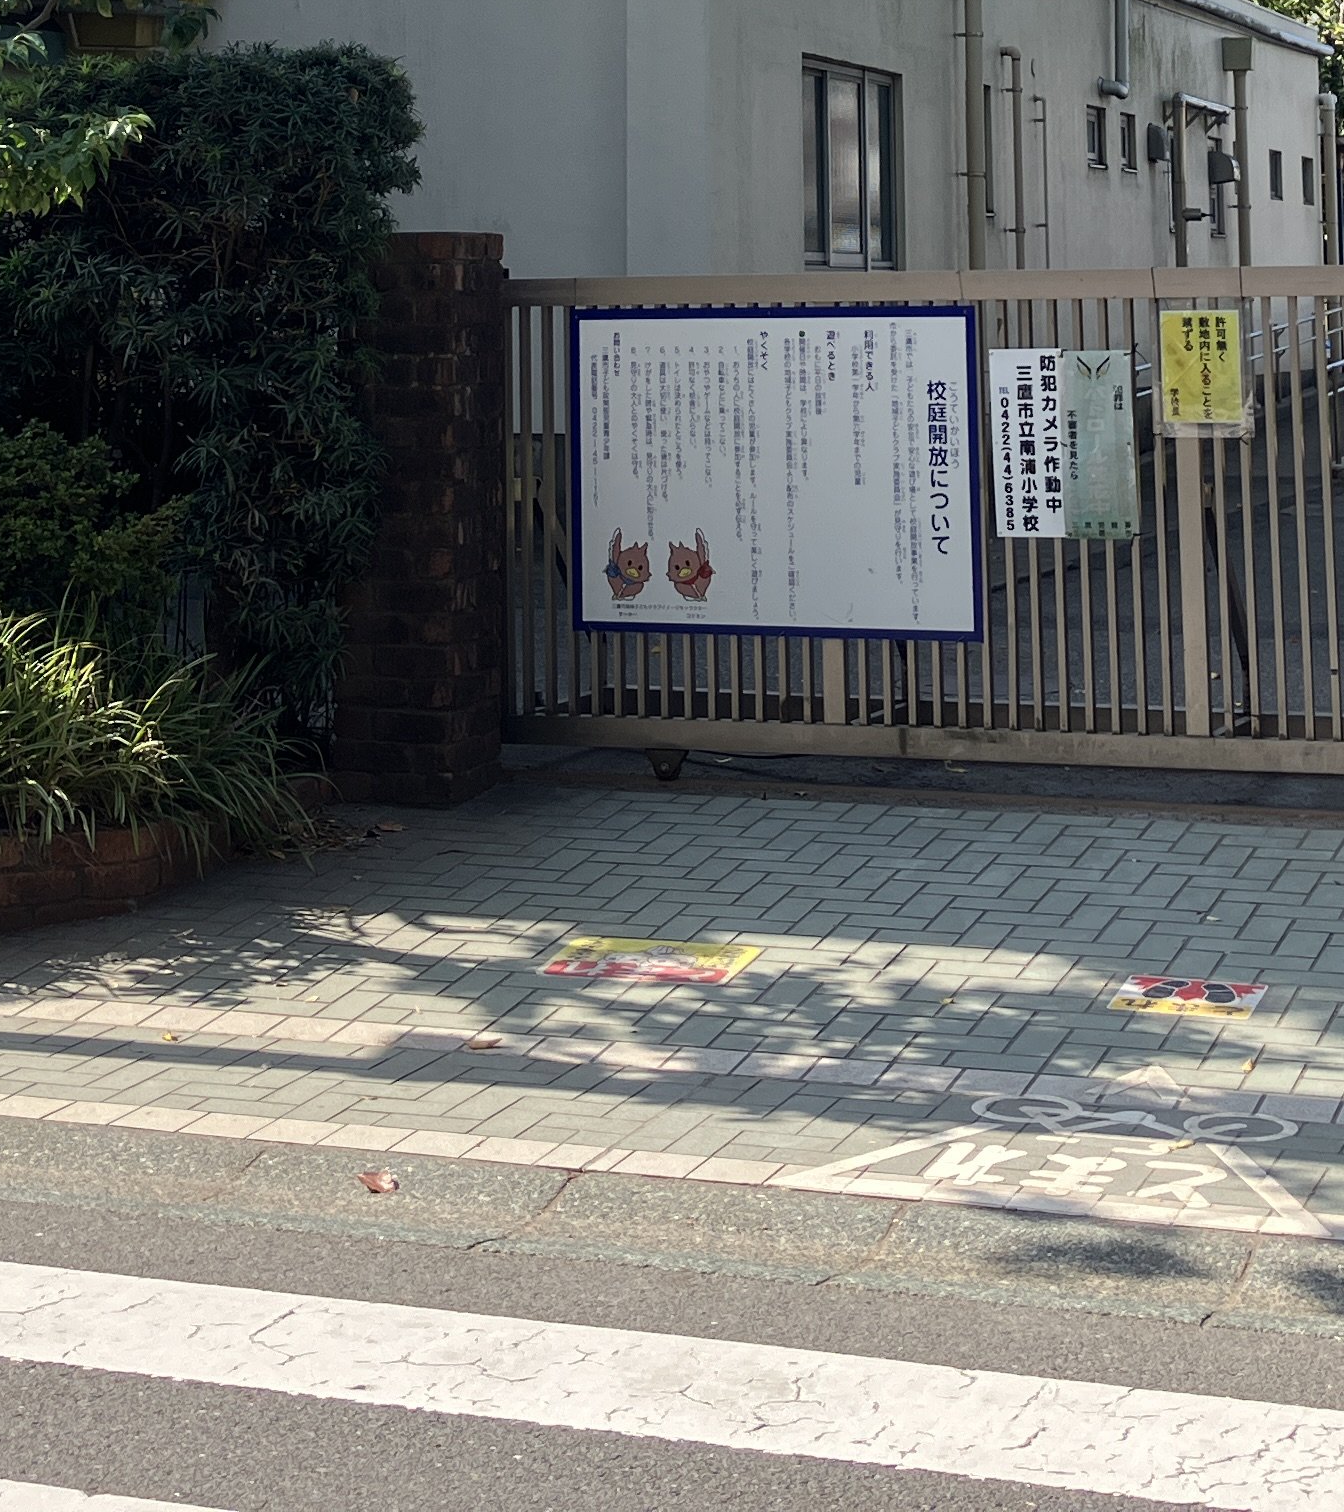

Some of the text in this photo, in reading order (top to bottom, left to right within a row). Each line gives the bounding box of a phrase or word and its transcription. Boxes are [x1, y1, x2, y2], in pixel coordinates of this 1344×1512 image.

[759, 330, 769, 371] やくそく
[825, 330, 836, 382] 遊べるとき
[863, 330, 874, 392] 利用できる人
[1198, 316, 1213, 420] 敷地内に入ることを
[1215, 316, 1227, 362] 許可無く
[948, 381, 961, 470] こうていかいほう
[1000, 397, 1015, 531] 0422(44)6385
[1016, 365, 1039, 532] 三鷹市立南浦小学校
[1039, 355, 1062, 514] 防犯カメラ作動中
[1066, 410, 1079, 481] 不審者を見たら
[926, 379, 949, 555] 校庭開放について
[922, 1139, 1228, 1210] とまれ
